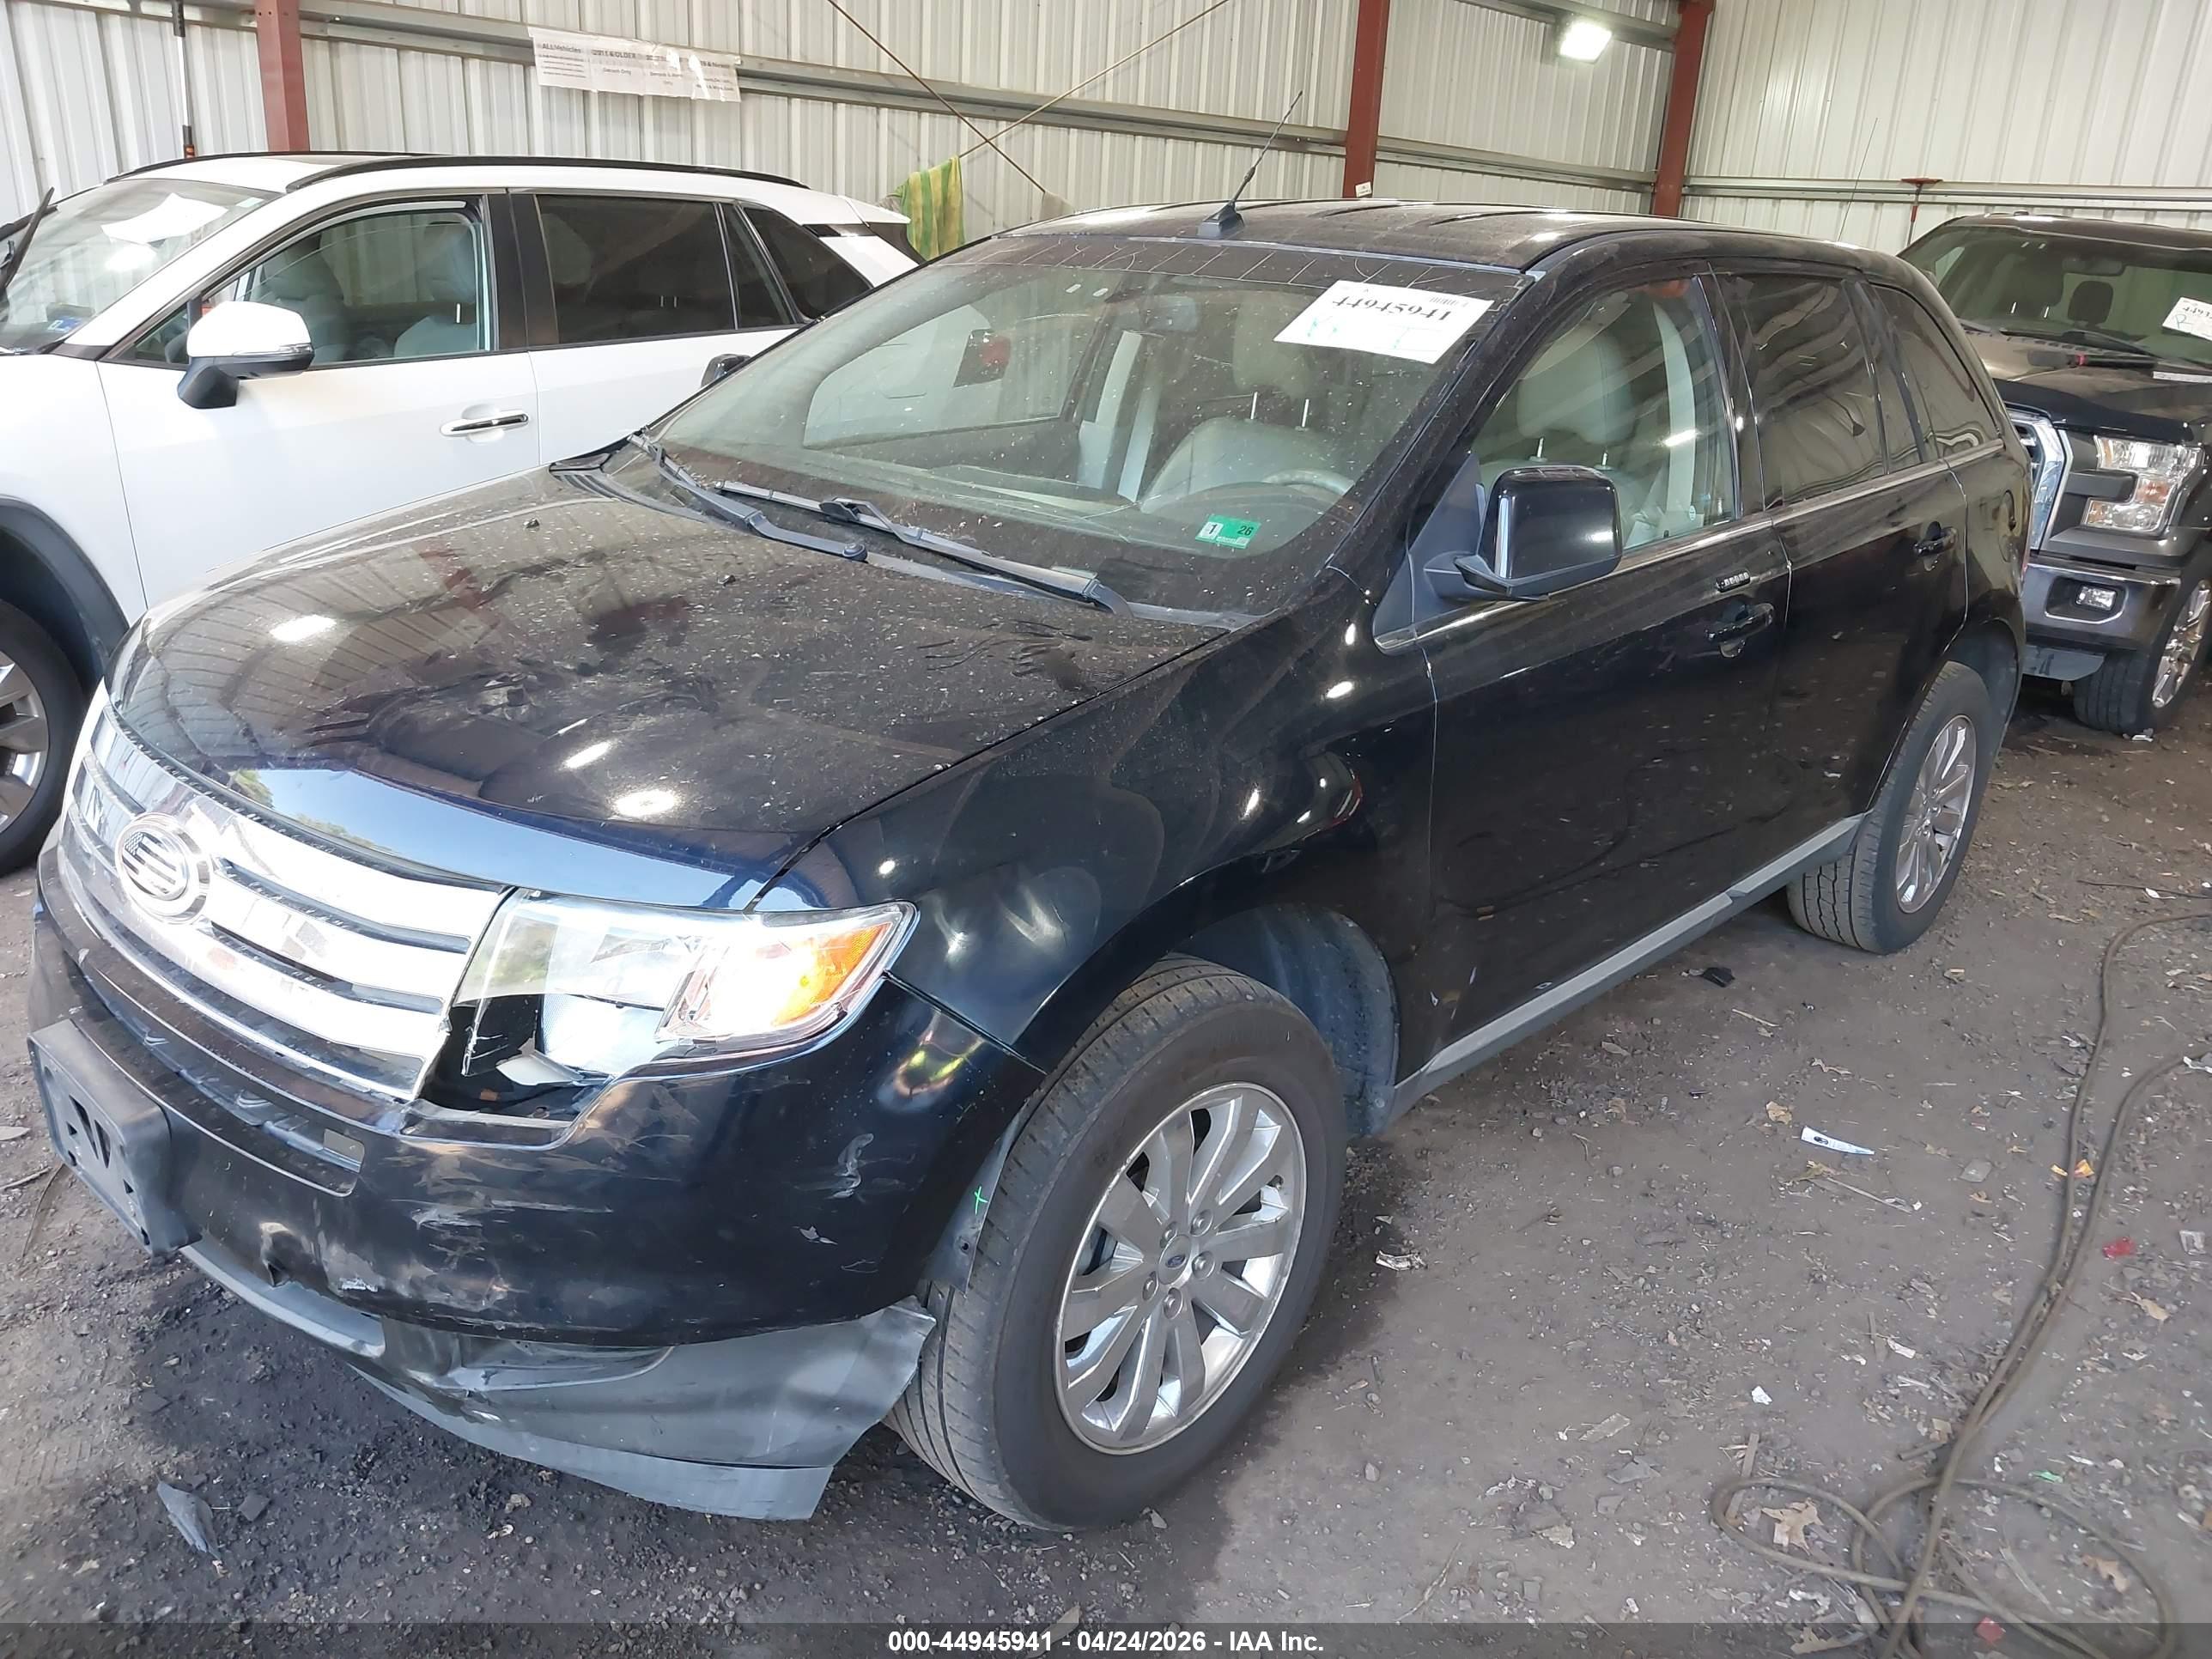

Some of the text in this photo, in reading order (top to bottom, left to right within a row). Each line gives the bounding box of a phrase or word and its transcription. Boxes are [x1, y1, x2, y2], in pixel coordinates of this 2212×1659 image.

[1333, 296, 1451, 320] 44945941
[1208, 524, 1255, 536] 1 26
